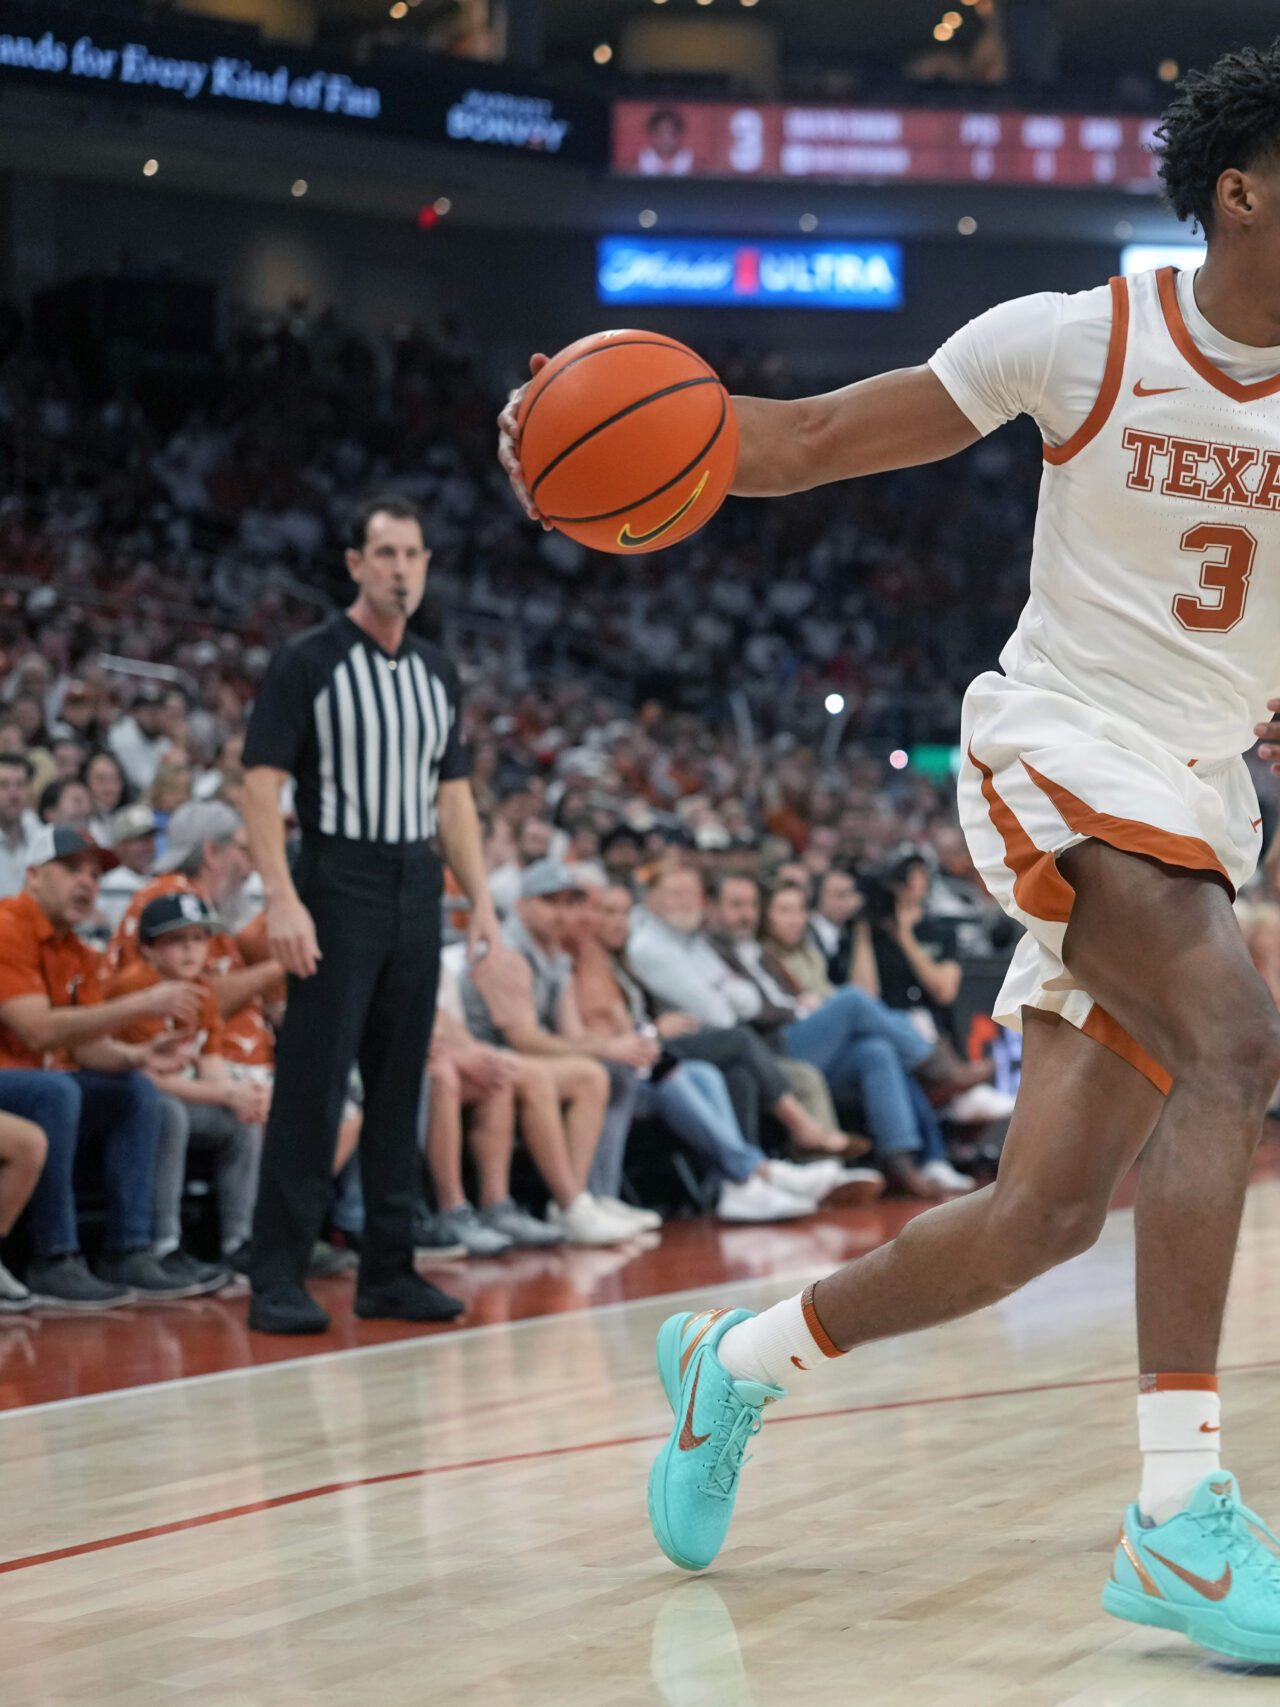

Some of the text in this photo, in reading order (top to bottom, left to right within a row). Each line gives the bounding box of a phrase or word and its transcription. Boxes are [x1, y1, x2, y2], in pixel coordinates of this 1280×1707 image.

[71, 36, 119, 79] for
[121, 43, 208, 98] Every
[212, 57, 288, 104] Kind
[288, 71, 324, 110] of
[324, 74, 381, 118] Fan
[760, 252, 895, 292] ULTRA
[1171, 522, 1258, 634] 3
